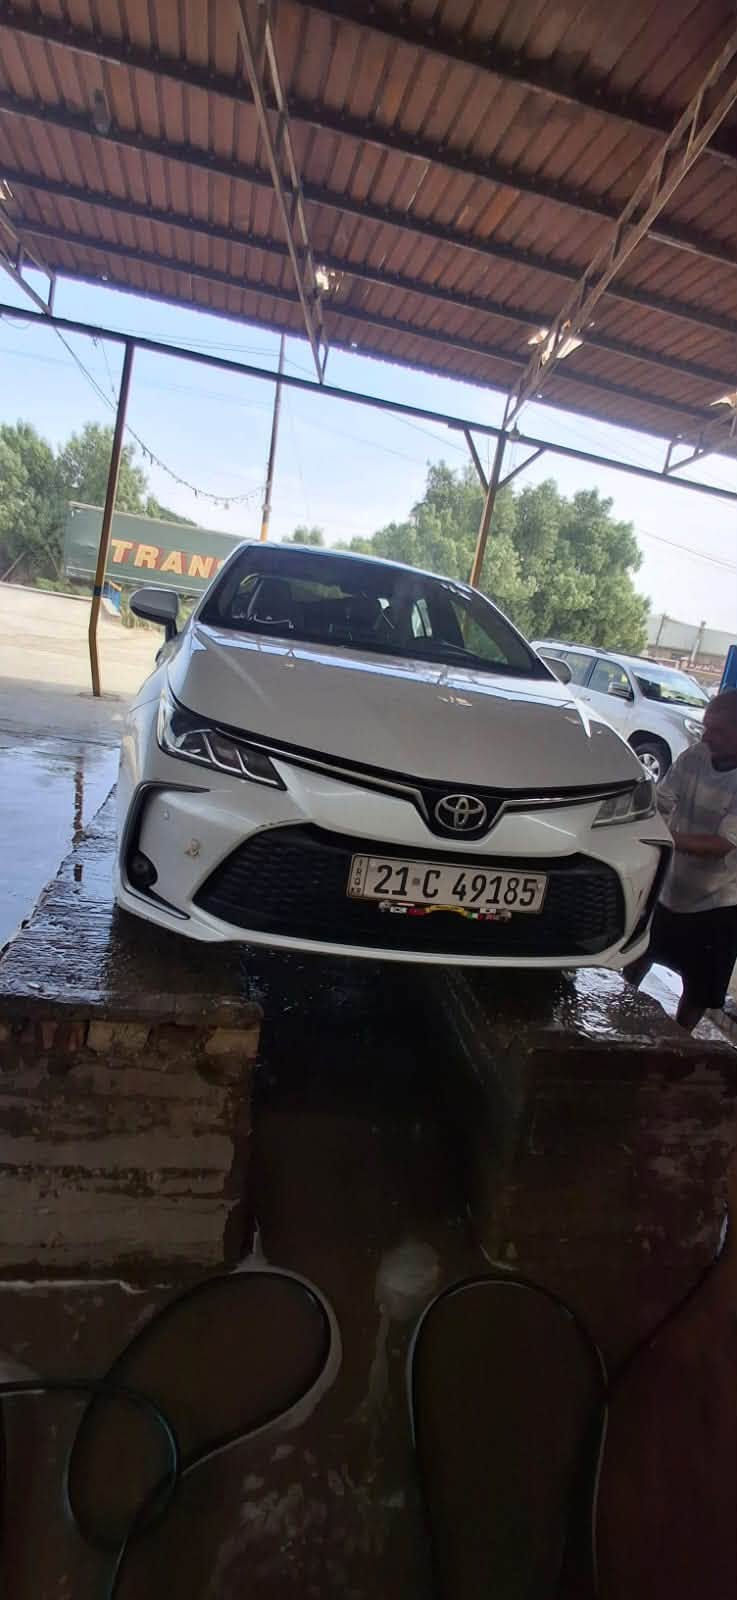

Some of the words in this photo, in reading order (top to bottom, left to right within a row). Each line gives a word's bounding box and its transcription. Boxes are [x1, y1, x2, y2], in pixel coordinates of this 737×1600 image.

[111, 539, 224, 579] TRAN
[374, 865, 408, 896] 21
[422, 869, 441, 898] C
[452, 872, 537, 906] 49185
